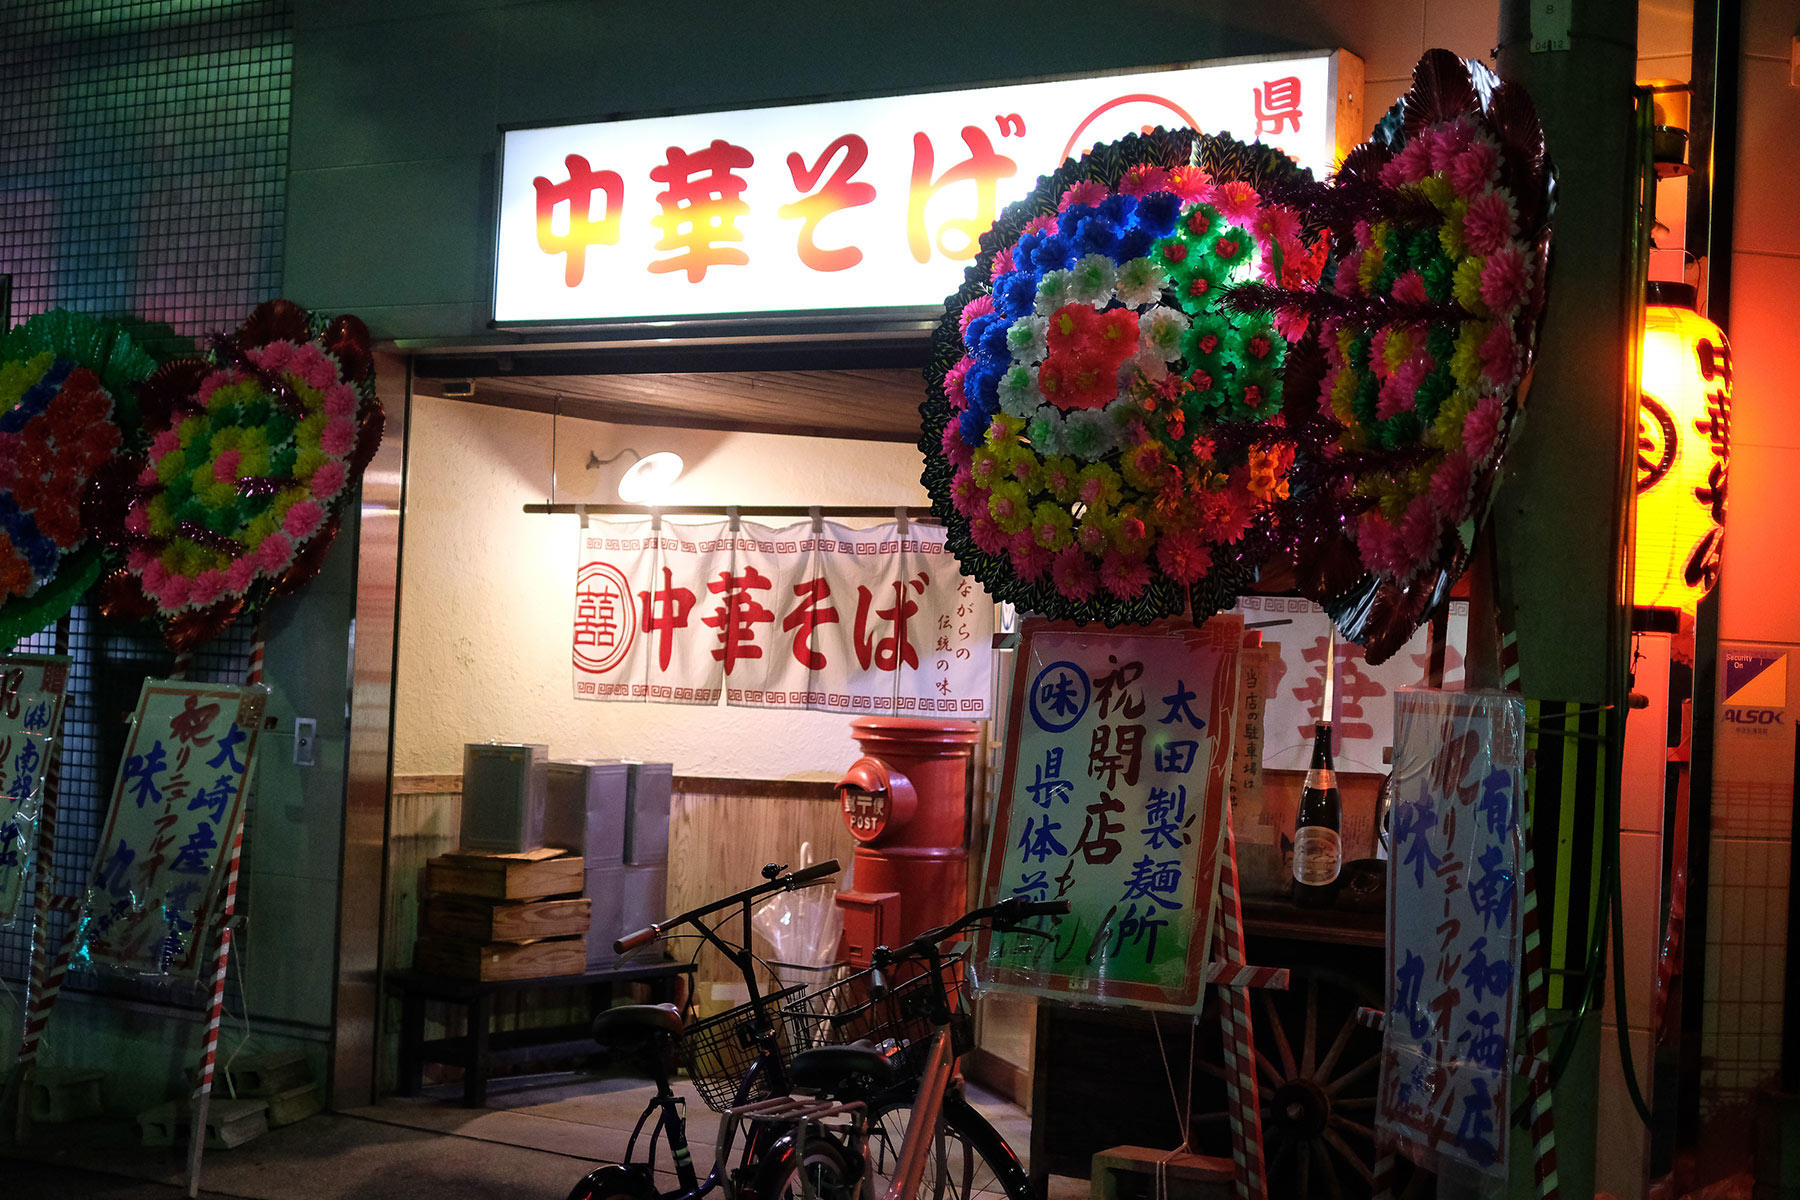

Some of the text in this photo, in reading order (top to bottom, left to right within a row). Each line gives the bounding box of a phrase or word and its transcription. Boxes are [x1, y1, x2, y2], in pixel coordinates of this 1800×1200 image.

[534, 114, 1026, 288] 中華そば
[638, 565, 930, 676] 中華そば
[935, 614, 953, 696] 伝統の味
[955, 579, 975, 661] ながらの
[1727, 654, 1752, 663] Security
[1069, 654, 1147, 866] 祝開店
[1242, 668, 1259, 790] 当店の駐車場は
[1721, 709, 1784, 724] ALSOK
[850, 815, 878, 832] POST
[1111, 680, 1206, 964] 太田製麺所
